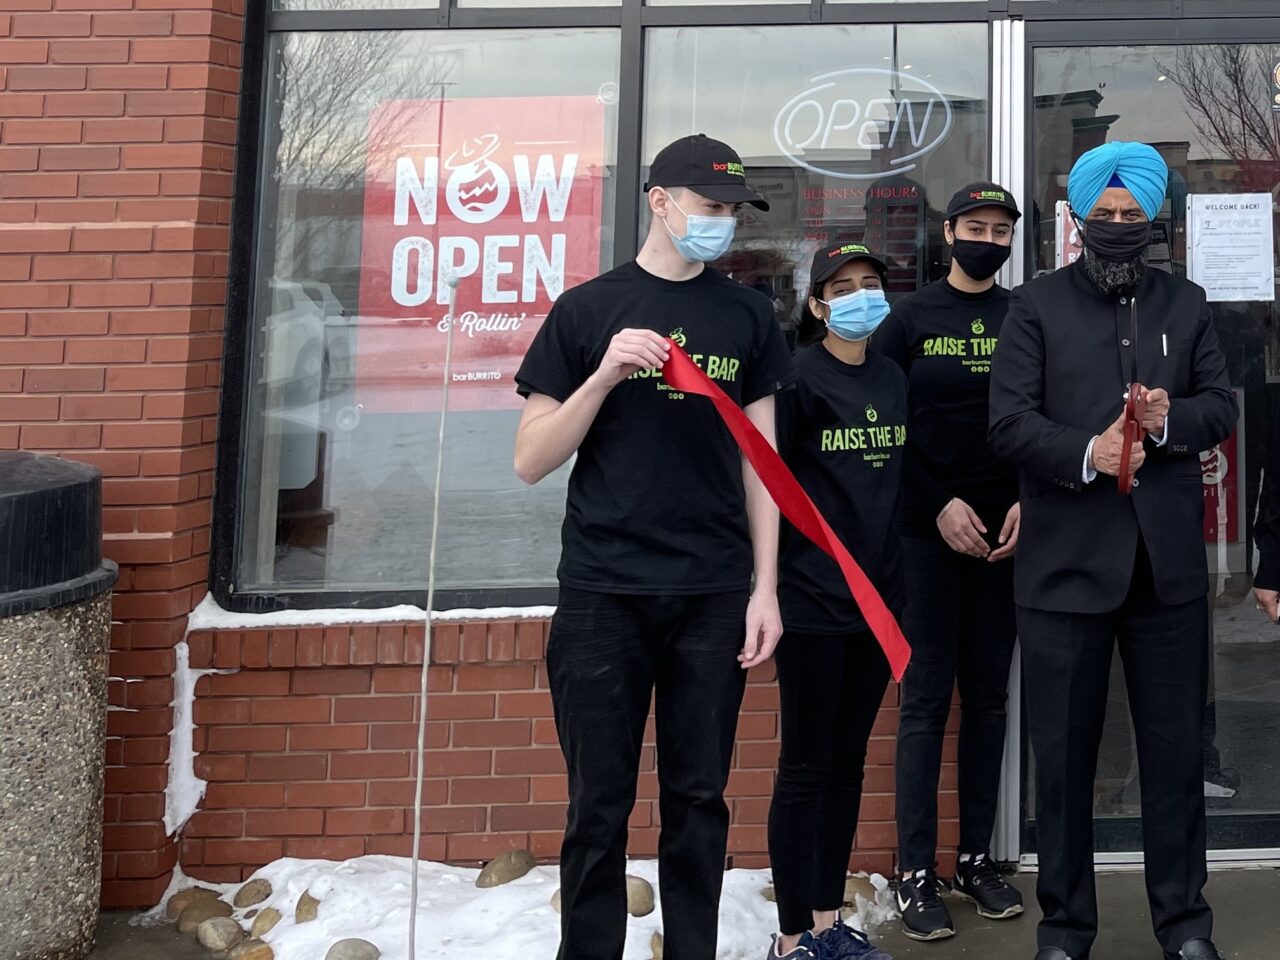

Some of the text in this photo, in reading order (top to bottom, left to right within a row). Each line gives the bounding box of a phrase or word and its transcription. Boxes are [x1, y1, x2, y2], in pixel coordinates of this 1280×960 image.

[784, 98, 935, 150] OPEN
[393, 145, 579, 226] NOW
[803, 186, 918, 200] BUSINESS HOURS
[391, 233, 566, 307] OPEN
[437, 311, 526, 338] & Rollin'
[923, 336, 967, 356] RAISE
[706, 355, 740, 382] BAR
[821, 427, 868, 452] RAISE
[866, 425, 893, 448] THE
